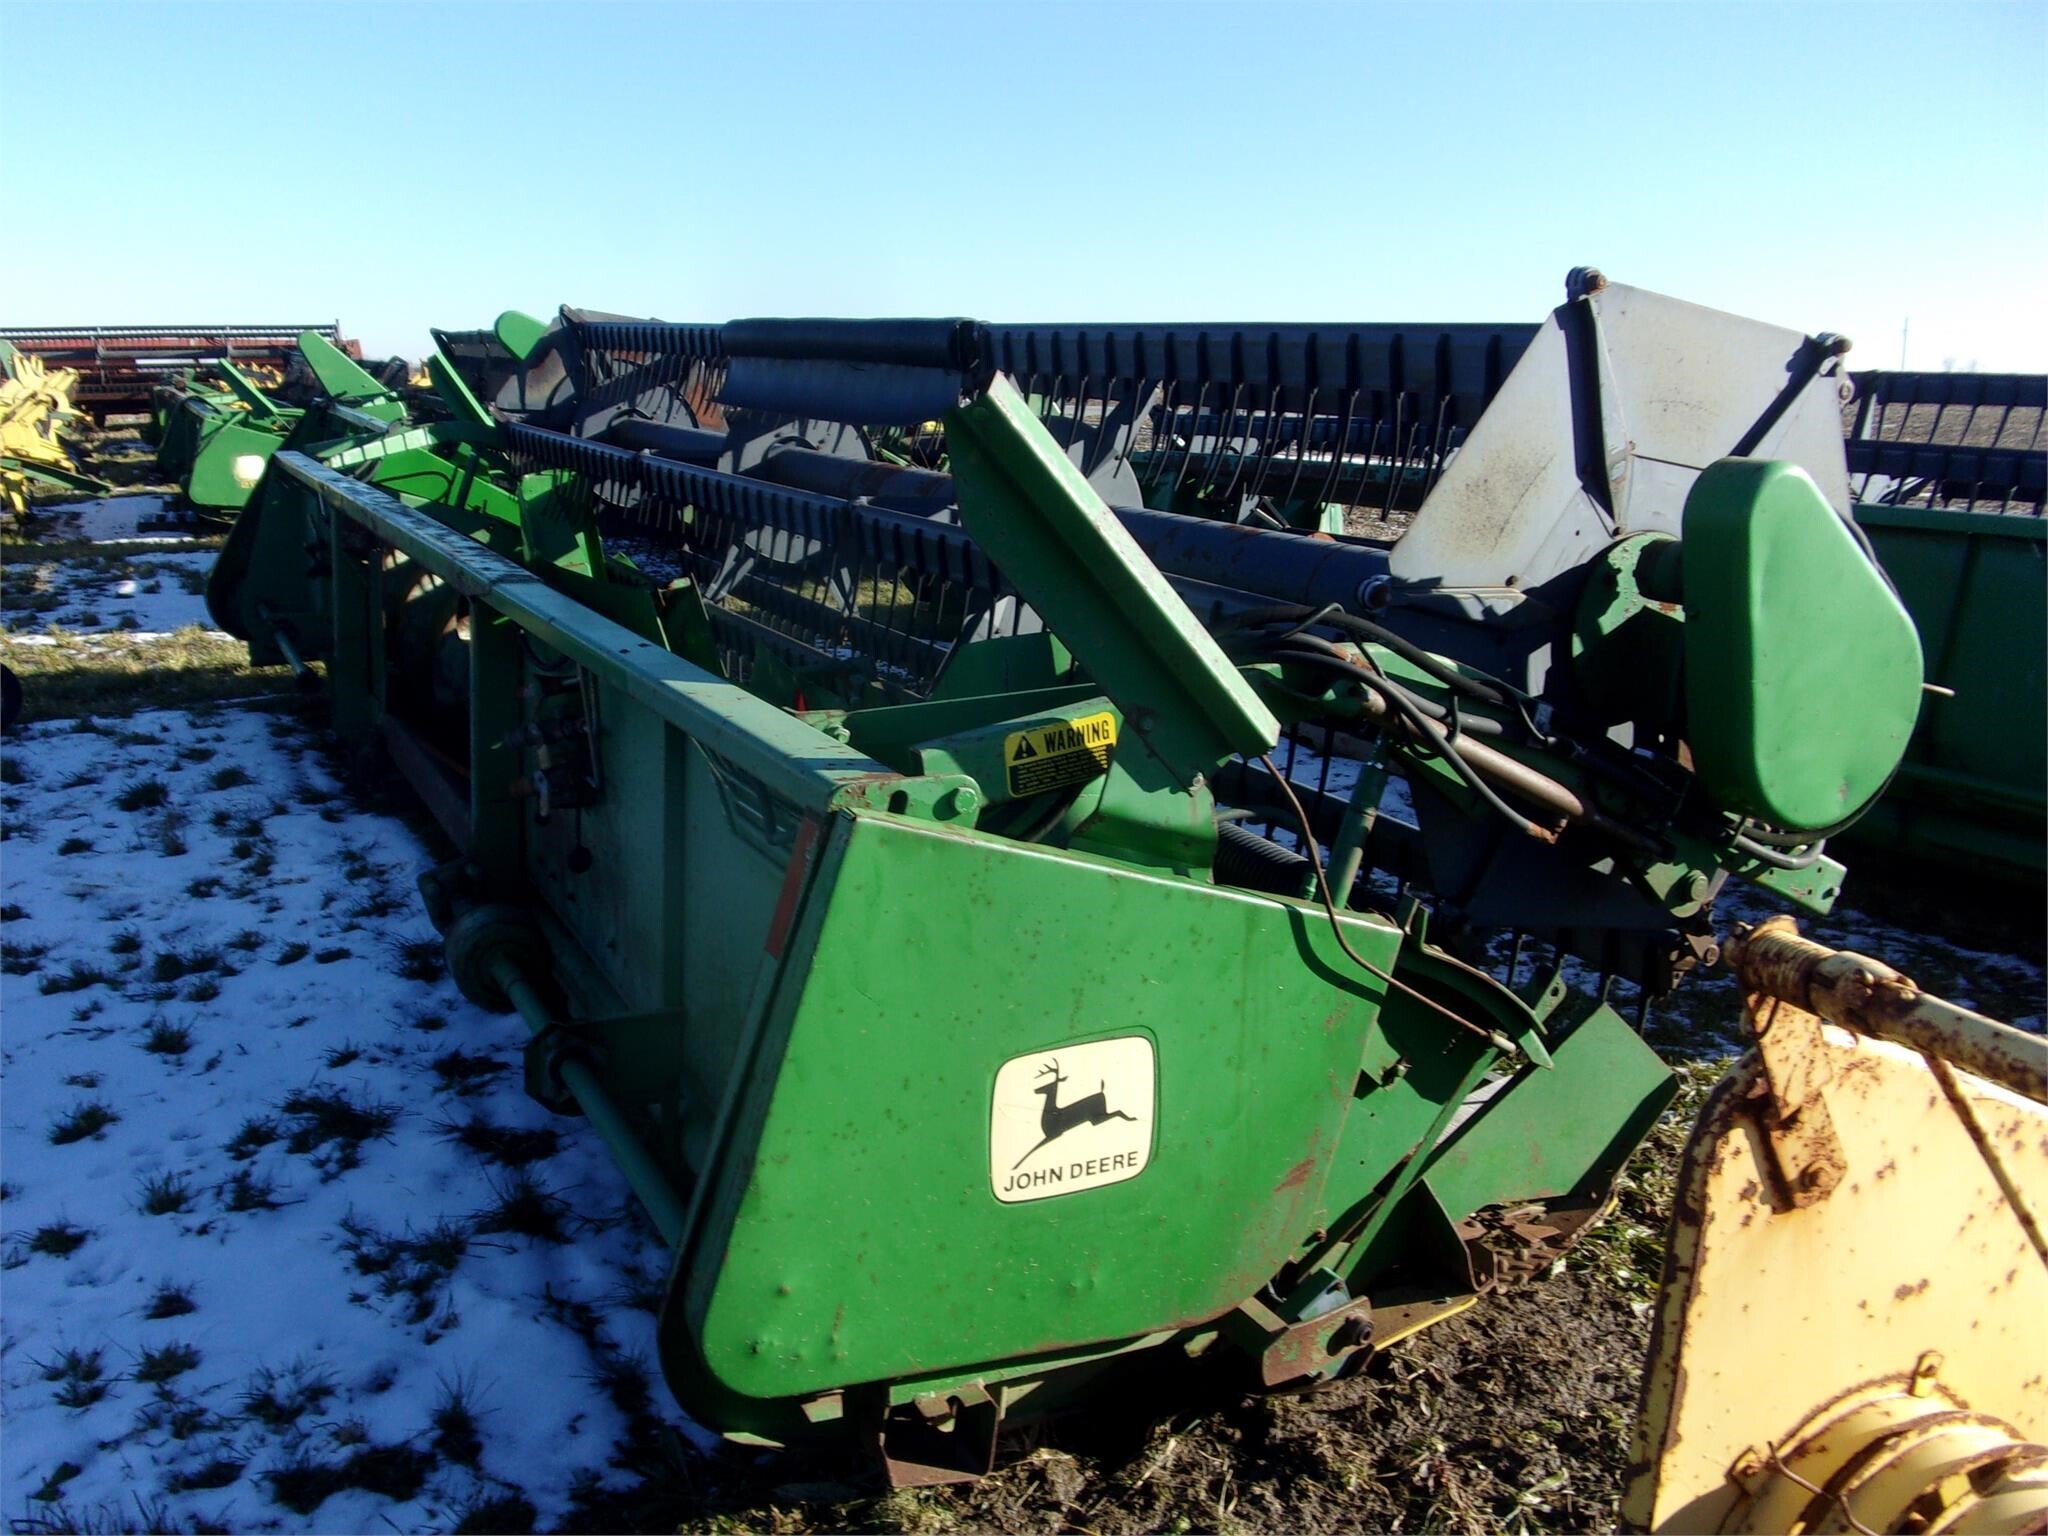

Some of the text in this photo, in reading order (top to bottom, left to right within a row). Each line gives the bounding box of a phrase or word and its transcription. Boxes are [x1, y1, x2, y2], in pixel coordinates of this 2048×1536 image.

[1044, 720, 1110, 753] WARNING
[1004, 1151, 1138, 1192] JOHN DEERE
